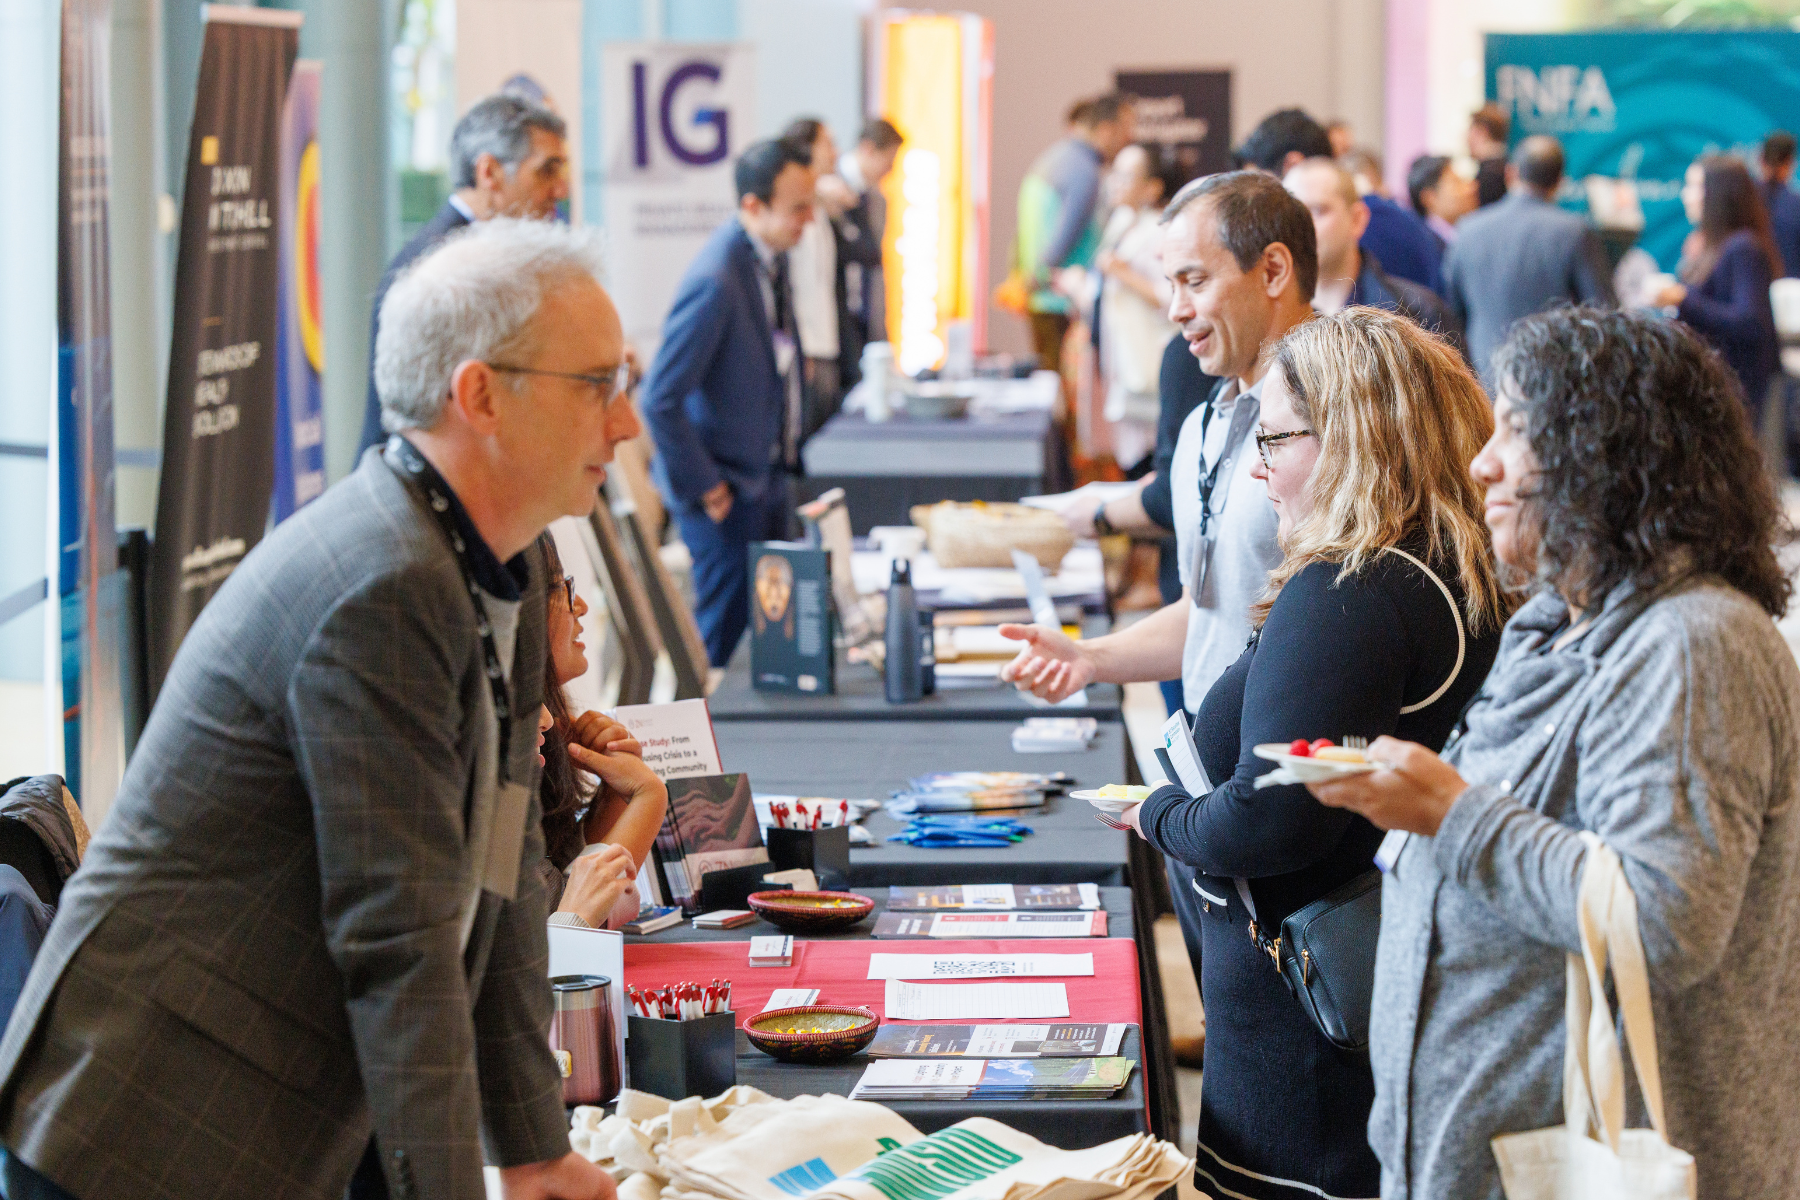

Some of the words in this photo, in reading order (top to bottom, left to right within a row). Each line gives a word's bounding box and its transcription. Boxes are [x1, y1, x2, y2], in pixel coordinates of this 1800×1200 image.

[634, 61, 728, 168] IG
[649, 737, 670, 748] Study:
[671, 735, 690, 744] From
[642, 752, 662, 762] ousing
[663, 749, 682, 760] Crisis
[683, 749, 691, 758] to
[693, 749, 698, 757] a
[666, 762, 707, 774] Community
